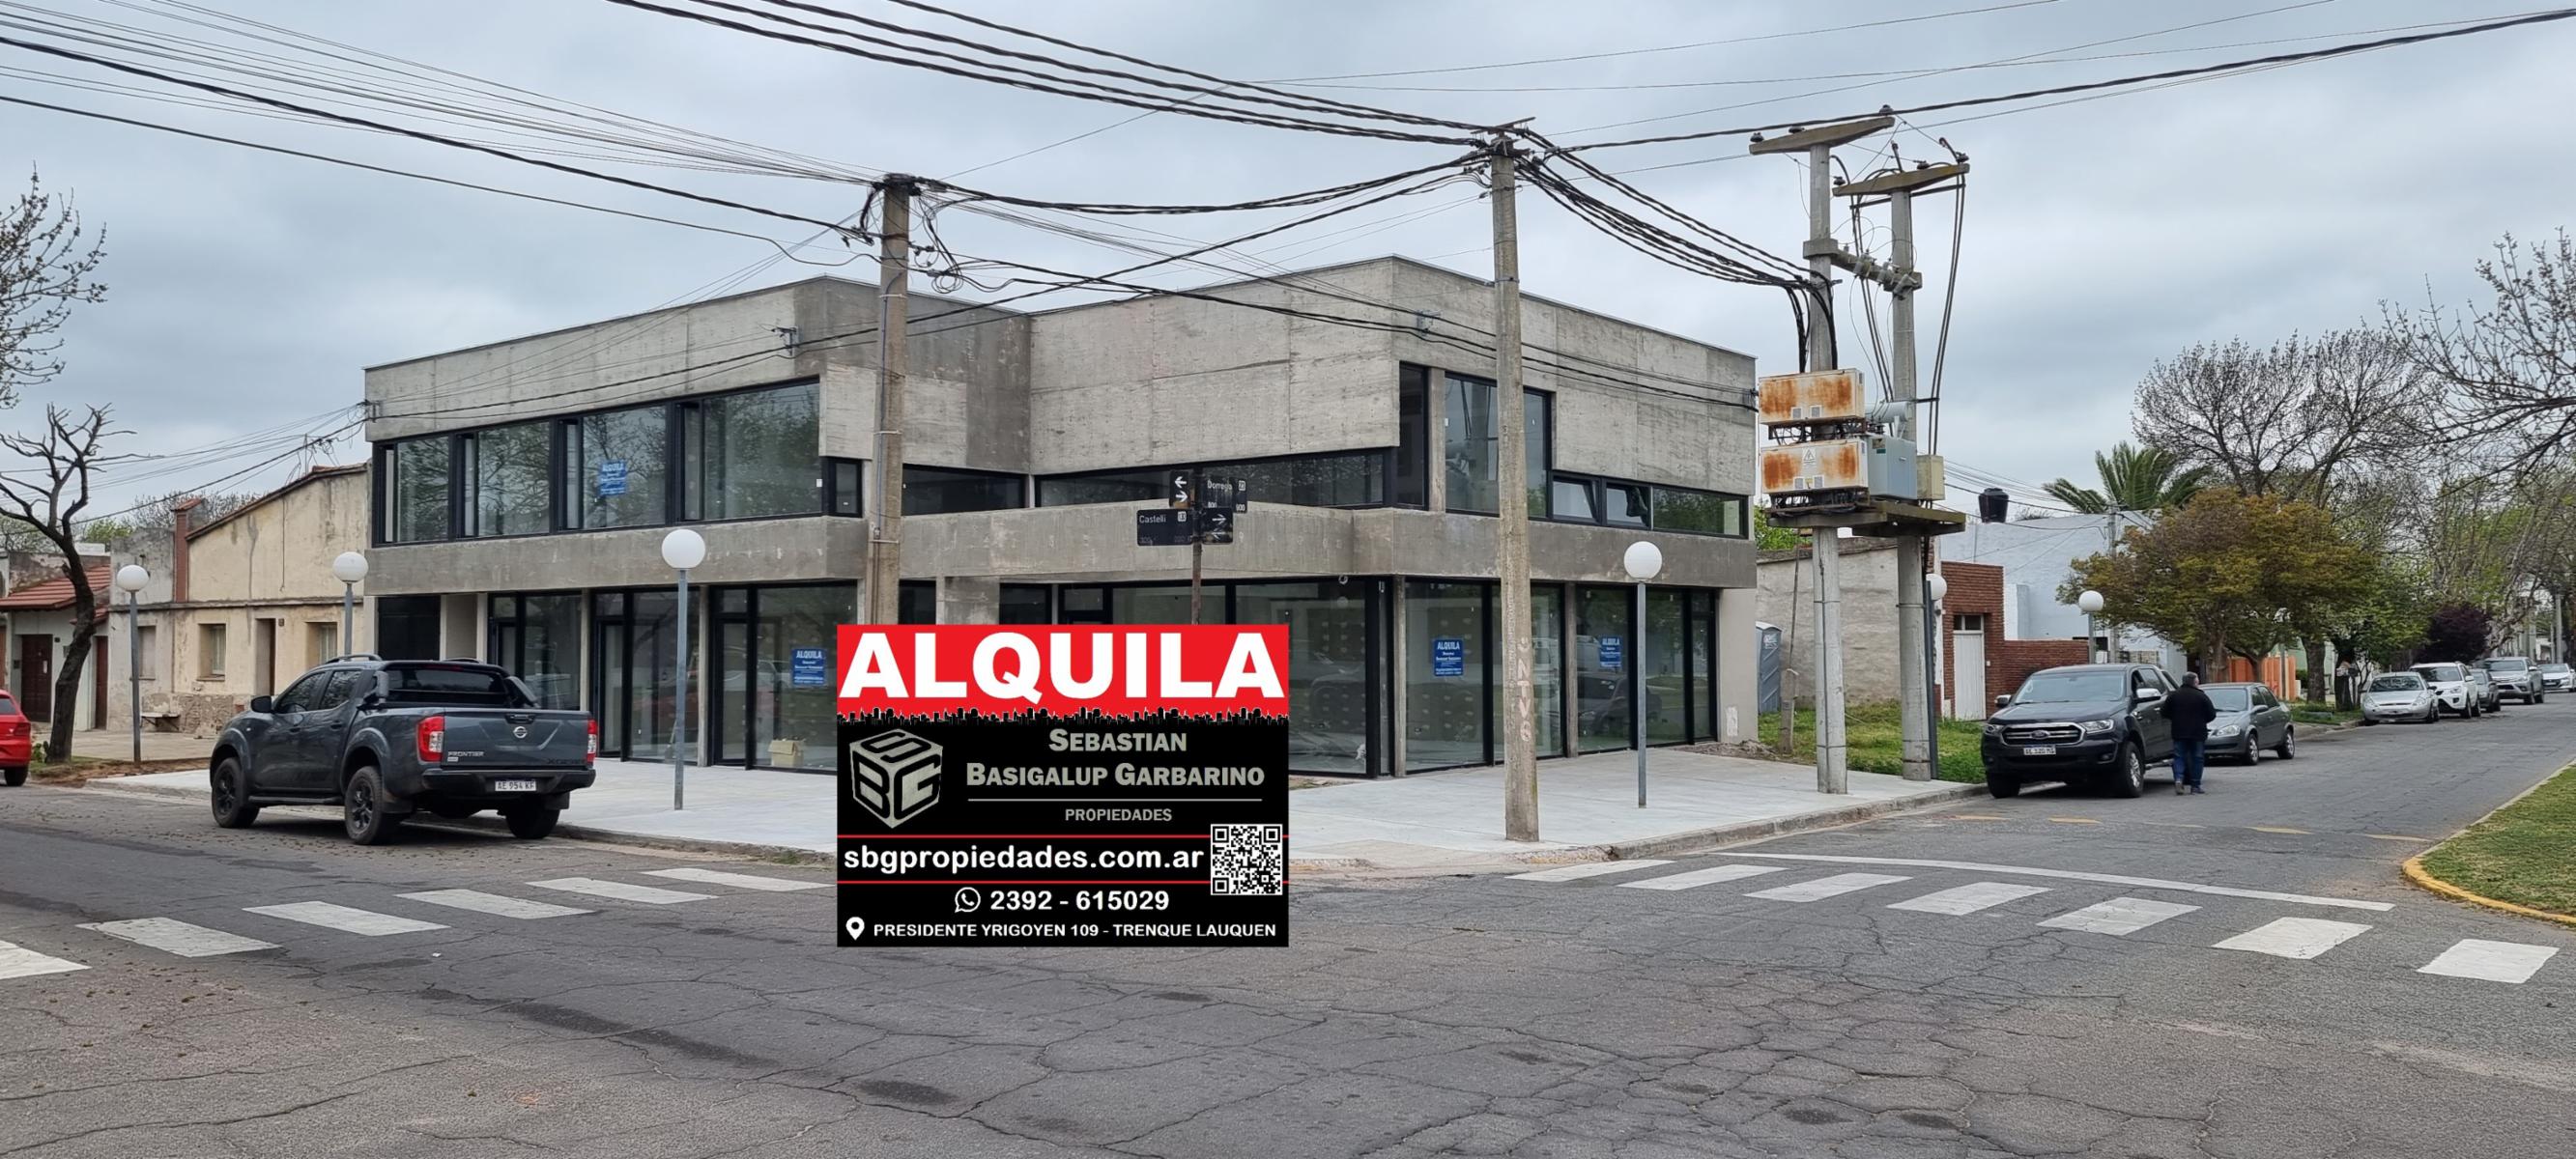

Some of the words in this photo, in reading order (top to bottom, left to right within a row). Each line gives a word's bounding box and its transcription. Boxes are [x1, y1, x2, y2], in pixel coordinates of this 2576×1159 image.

[1139, 515, 1166, 523] Castelli
[1437, 641, 1460, 650] ALQUILA
[796, 650, 822, 659] ALQUILA
[497, 780, 507, 790] AE
[509, 780, 524, 790] 954
